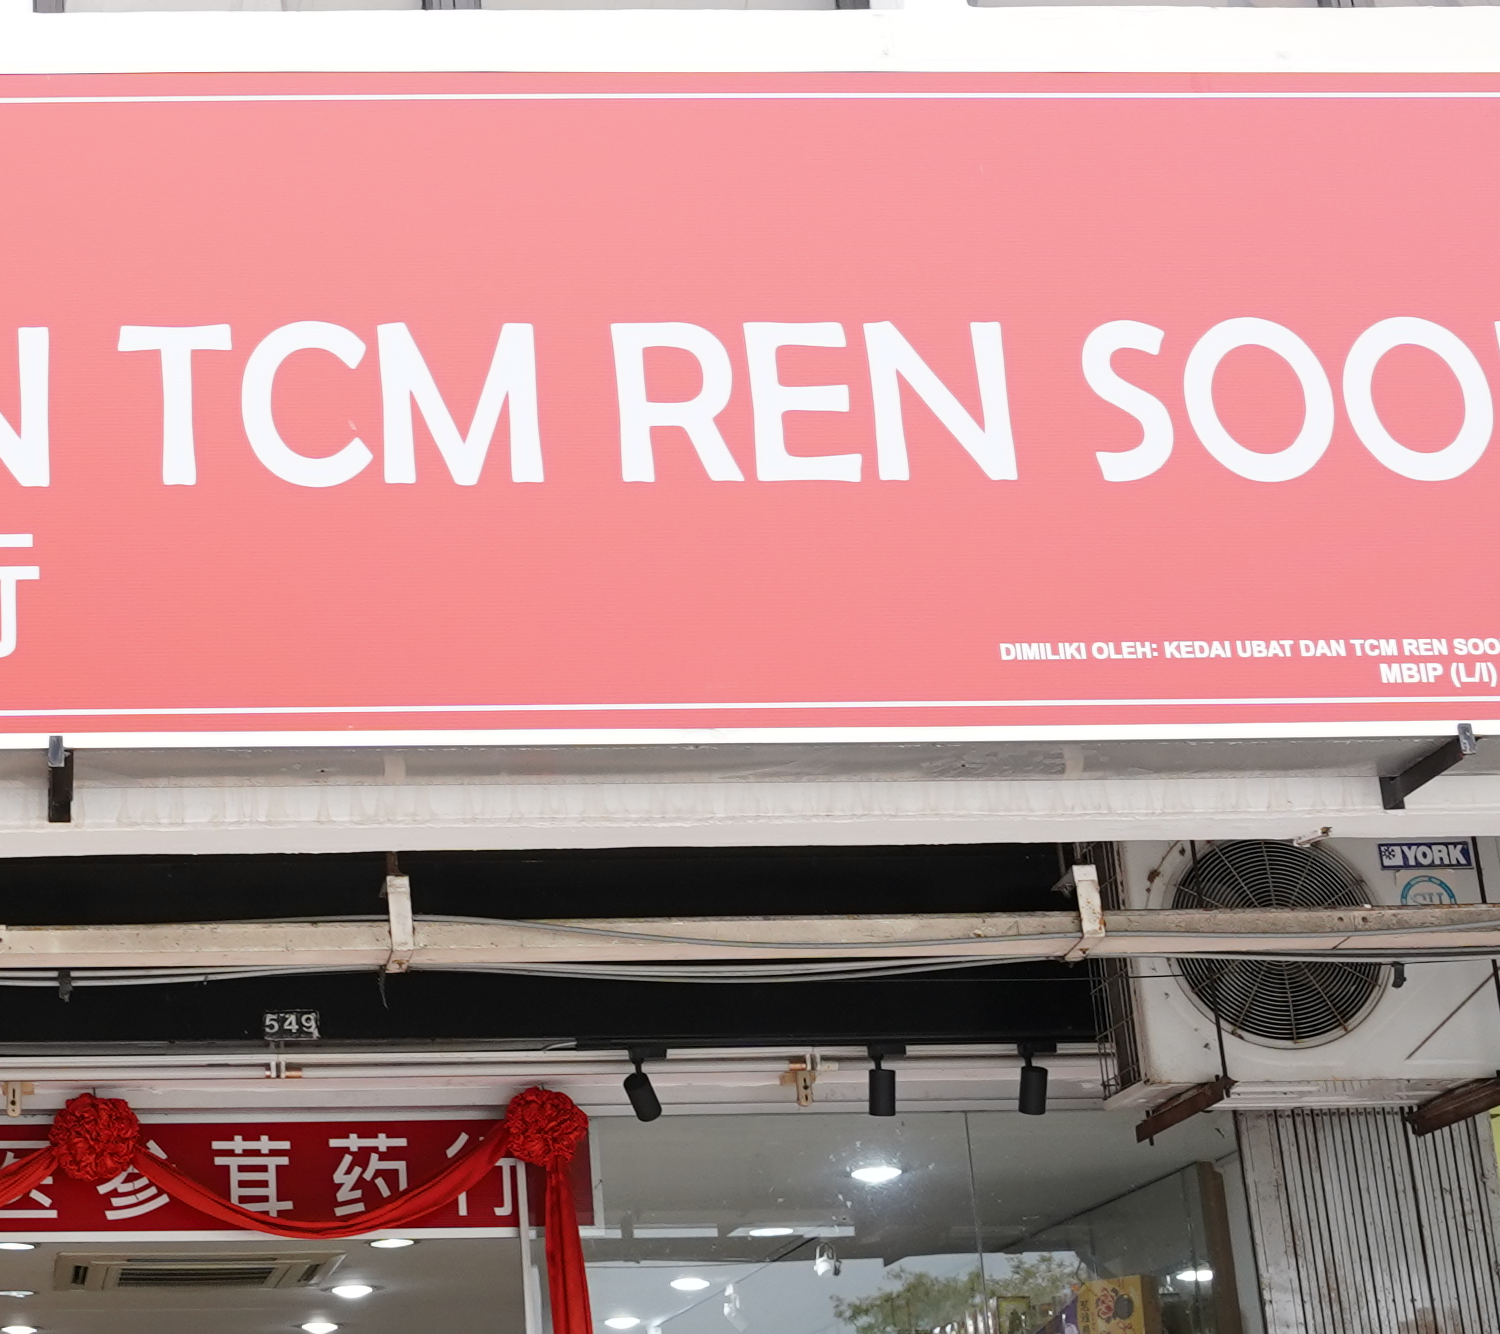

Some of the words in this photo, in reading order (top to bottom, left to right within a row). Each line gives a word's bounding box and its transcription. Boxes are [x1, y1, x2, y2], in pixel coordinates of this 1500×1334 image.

[118, 321, 545, 488] TCM
[611, 321, 1019, 483] REN
[999, 642, 1087, 661] DIMILIKI
[1091, 641, 1159, 660] OLEH:
[1163, 640, 1232, 659] KEDAI
[1235, 639, 1294, 658] UBAT
[1298, 639, 1347, 657] DAN
[1350, 638, 1399, 657] TCM
[1402, 638, 1449, 656] REN
[1379, 662, 1444, 683] MBIP
[1401, 844, 1468, 865] YORK
[264, 1013, 317, 1034] 549
